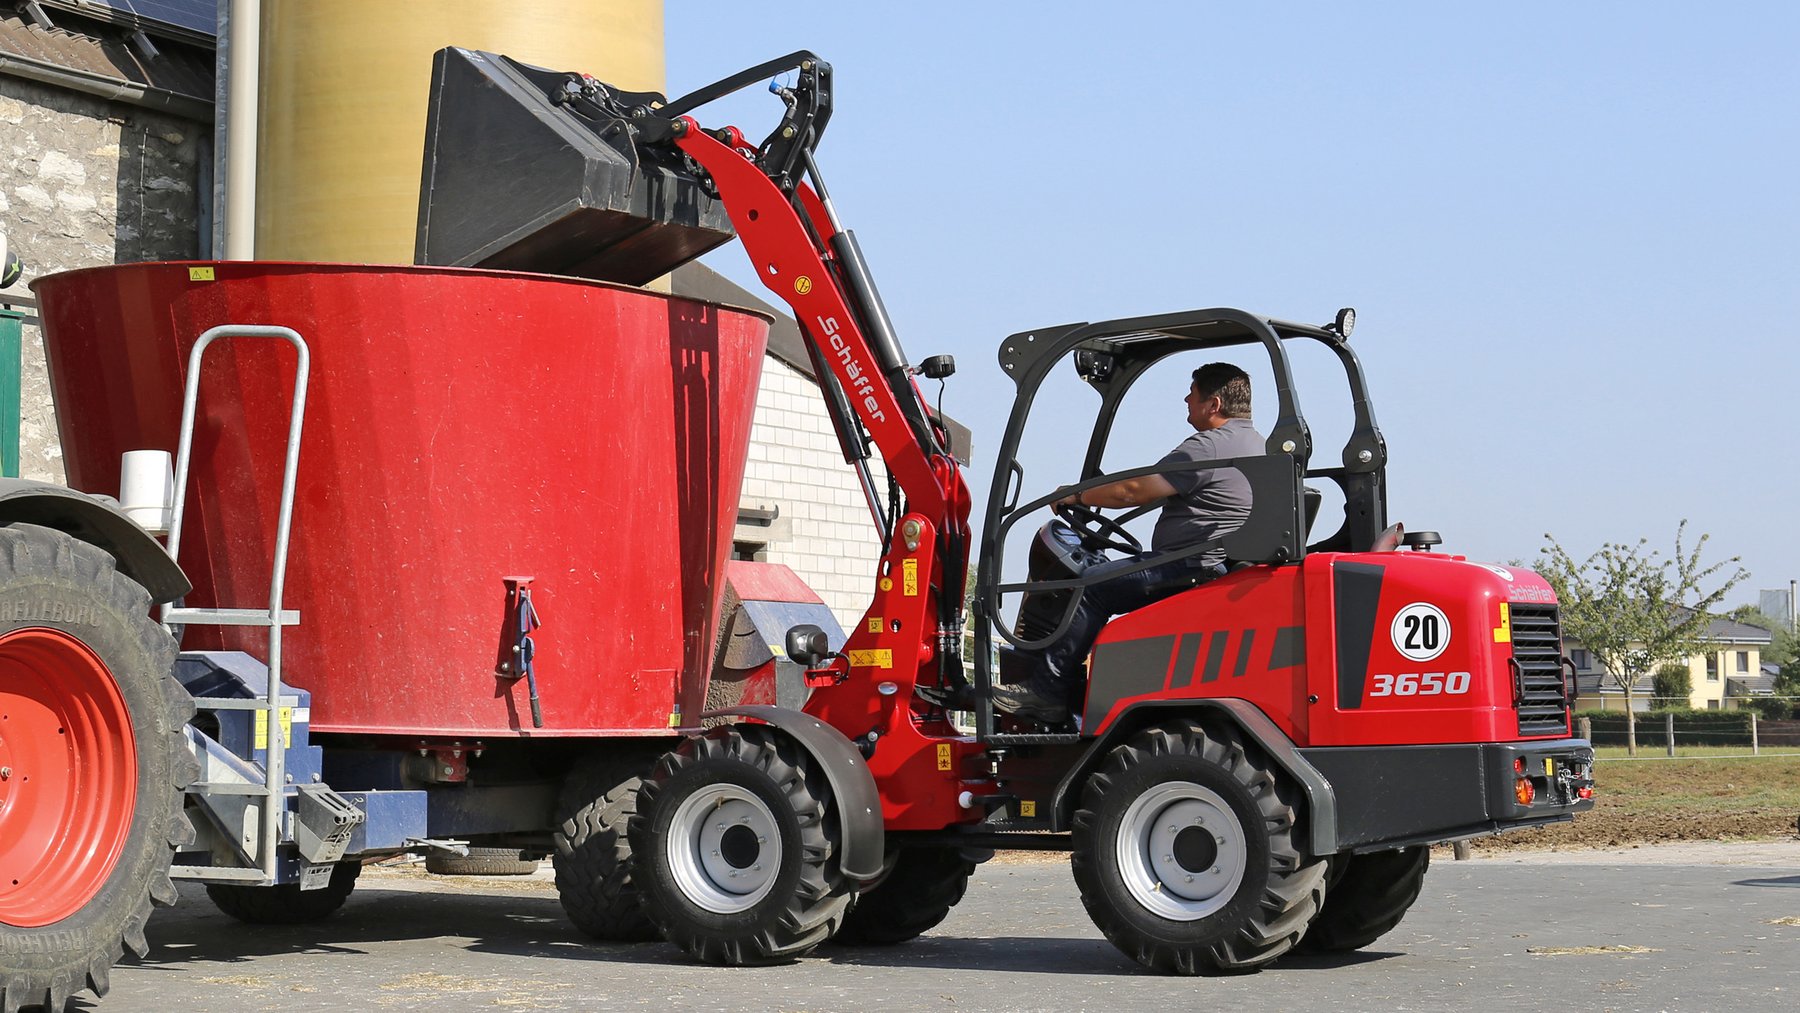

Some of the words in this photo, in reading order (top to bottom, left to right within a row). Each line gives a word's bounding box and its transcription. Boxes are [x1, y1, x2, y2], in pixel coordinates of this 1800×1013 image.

[817, 315, 885, 423] Schäffer
[1507, 584, 1552, 601] Schäffer
[1404, 614, 1439, 650] 20
[1369, 671, 1471, 697] 3650
